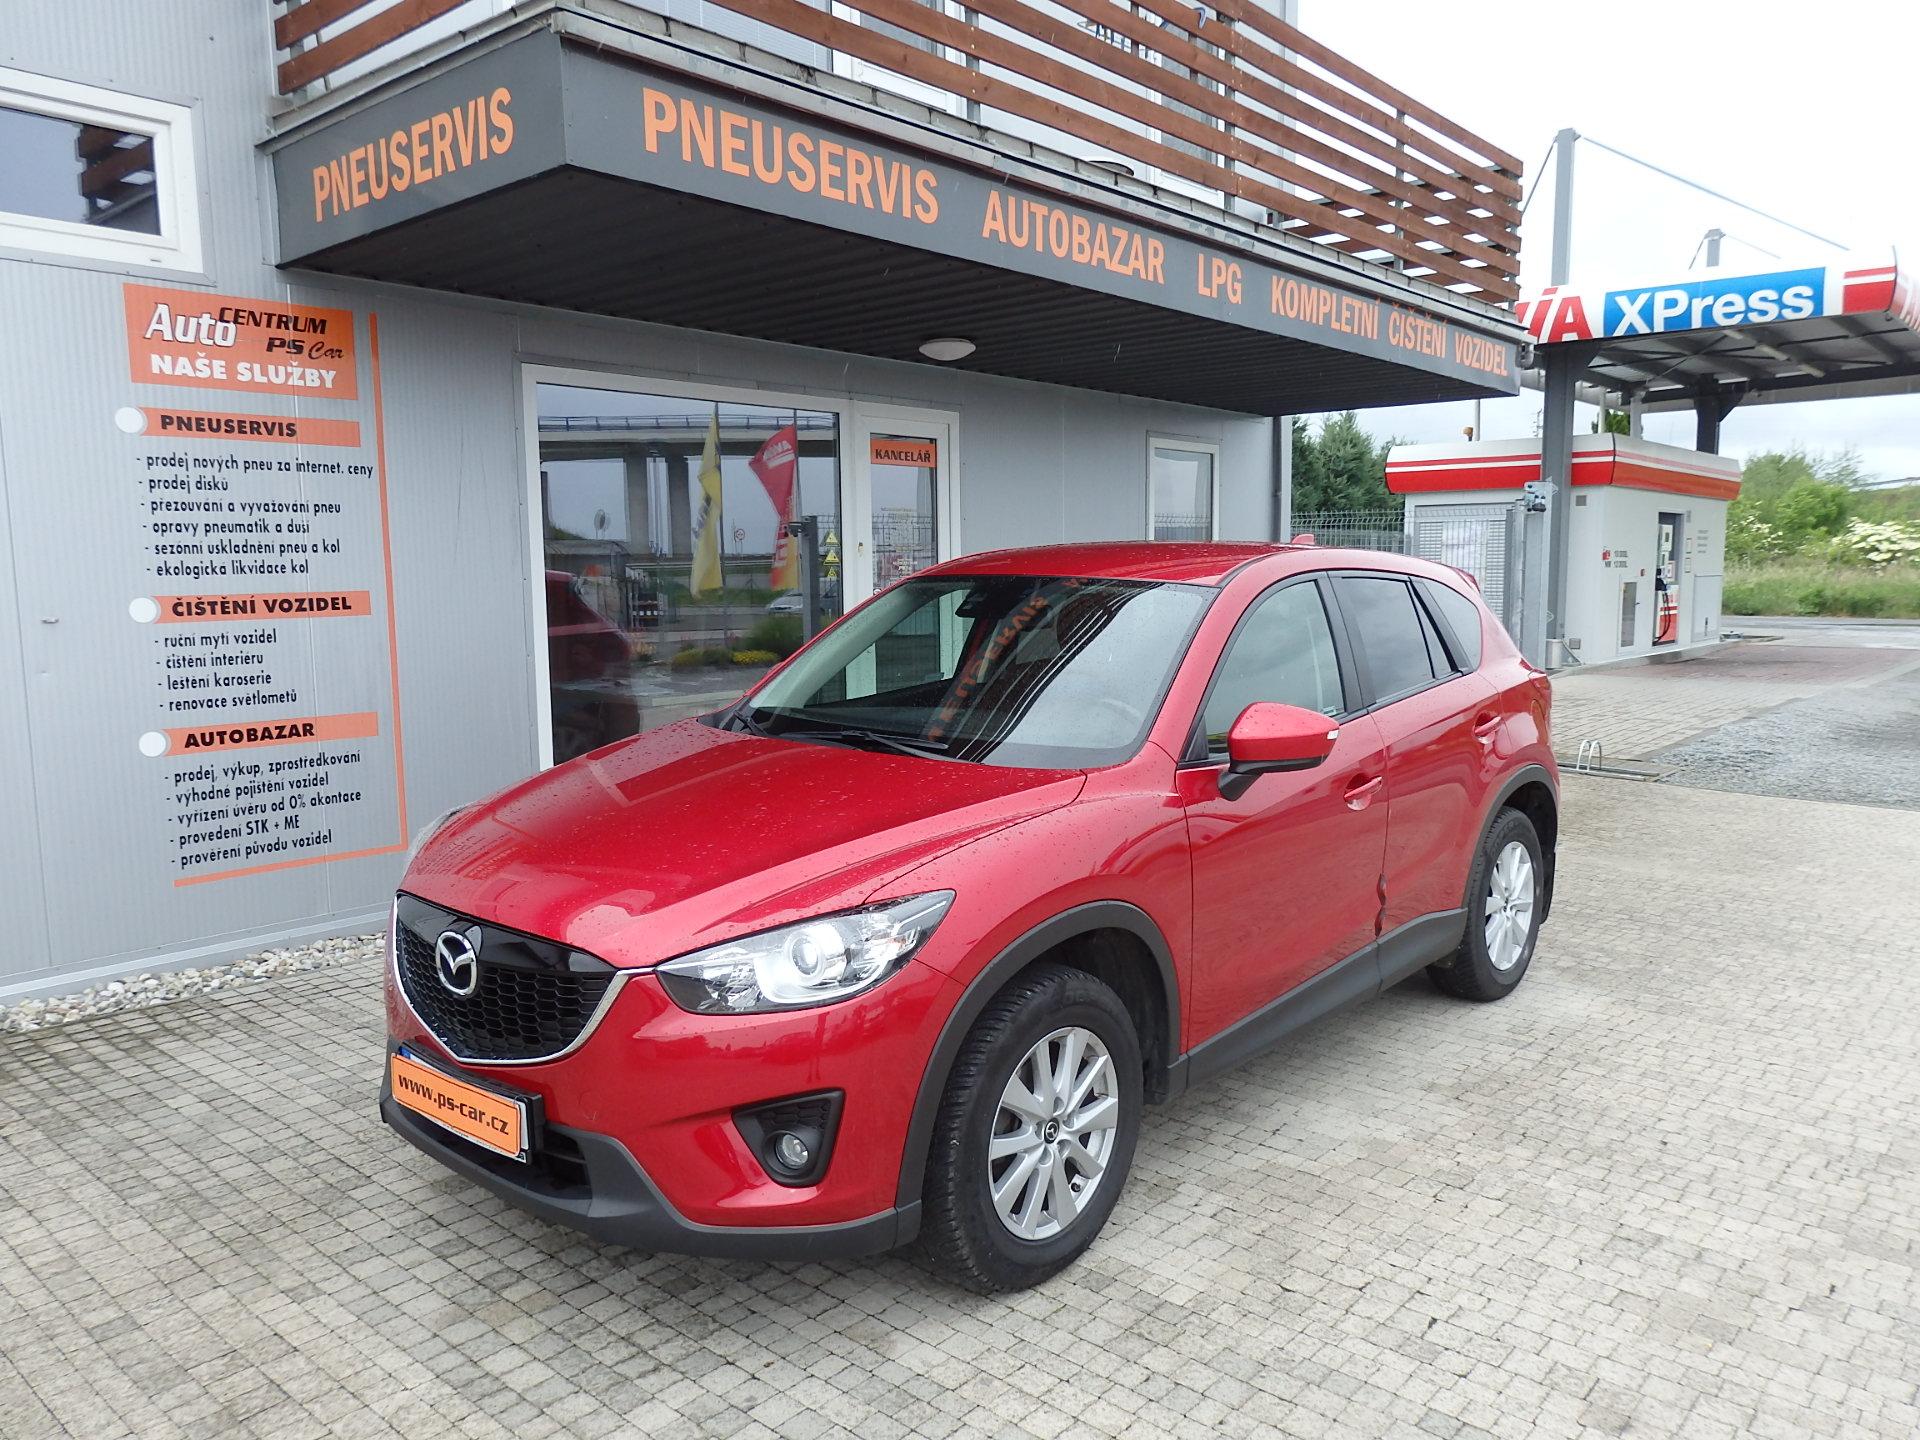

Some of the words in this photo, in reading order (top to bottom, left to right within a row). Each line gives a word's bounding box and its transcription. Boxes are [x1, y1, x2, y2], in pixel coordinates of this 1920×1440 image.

[313, 86, 514, 223] PNEUSERVIS
[642, 87, 939, 224] PNEUSERVIS
[981, 190, 1165, 285] AUTOBAZAR
[1197, 252, 1243, 305] LPG
[1271, 275, 1379, 341] KOMPLETNÍ
[1387, 302, 1447, 359] ČIŠTĚNÍ
[1454, 331, 1508, 377] VOZIDEL
[1612, 285, 1815, 338] XPress
[144, 302, 237, 347] Auto
[218, 306, 327, 335] CENTRUM
[266, 337, 304, 355] PS
[308, 341, 345, 360] Car
[151, 352, 228, 380] NAŠE
[236, 360, 337, 389] SLUŽBY
[160, 414, 298, 438] PNEUSERVIS
[146, 452, 189, 472] prodej
[193, 454, 239, 473] nových
[244, 459, 273, 474] pneu
[277, 461, 291, 471] za
[348, 464, 373, 479] ceny
[875, 449, 931, 463] KANCELÁŘ
[148, 474, 191, 494] prodej
[228, 502, 235, 512] a
[314, 503, 341, 517] pneu
[153, 522, 198, 537] opravy
[204, 518, 270, 537] pneumatik
[276, 523, 282, 533] a
[279, 543, 307, 557] pneu
[312, 543, 318, 553] a
[322, 538, 341, 553] kol
[156, 560, 227, 579] ekologická
[231, 559, 287, 575] likvidace
[291, 558, 309, 574] kol
[172, 595, 256, 617] ČIŠTĚNÍ
[263, 596, 352, 614] VOZIDEL
[164, 633, 196, 648] ruční
[233, 628, 277, 645] vozidel
[166, 653, 207, 669] čištění
[211, 650, 264, 666] interiéru
[167, 673, 210, 690] leštění
[214, 670, 272, 687] karoserie
[169, 697, 227, 711] renovace
[232, 688, 297, 706] světlometů
[184, 722, 315, 748] AUTOBAZAR
[268, 750, 360, 775] zprostředkování
[176, 784, 230, 807] výhodné
[236, 778, 285, 800] pojištění
[289, 771, 329, 790] vozidel
[178, 805, 229, 828] vyřízení
[233, 802, 267, 818] úvěru
[271, 796, 285, 811] od
[289, 794, 306, 809] 0%
[310, 791, 362, 807] akontace
[179, 824, 242, 849] provedení
[246, 818, 269, 836] STK
[284, 814, 300, 830] ME
[181, 843, 241, 870] prověření
[245, 836, 288, 860] původu
[292, 828, 332, 849] vozidel
[398, 1074, 509, 1136] www.ps-car.cz
